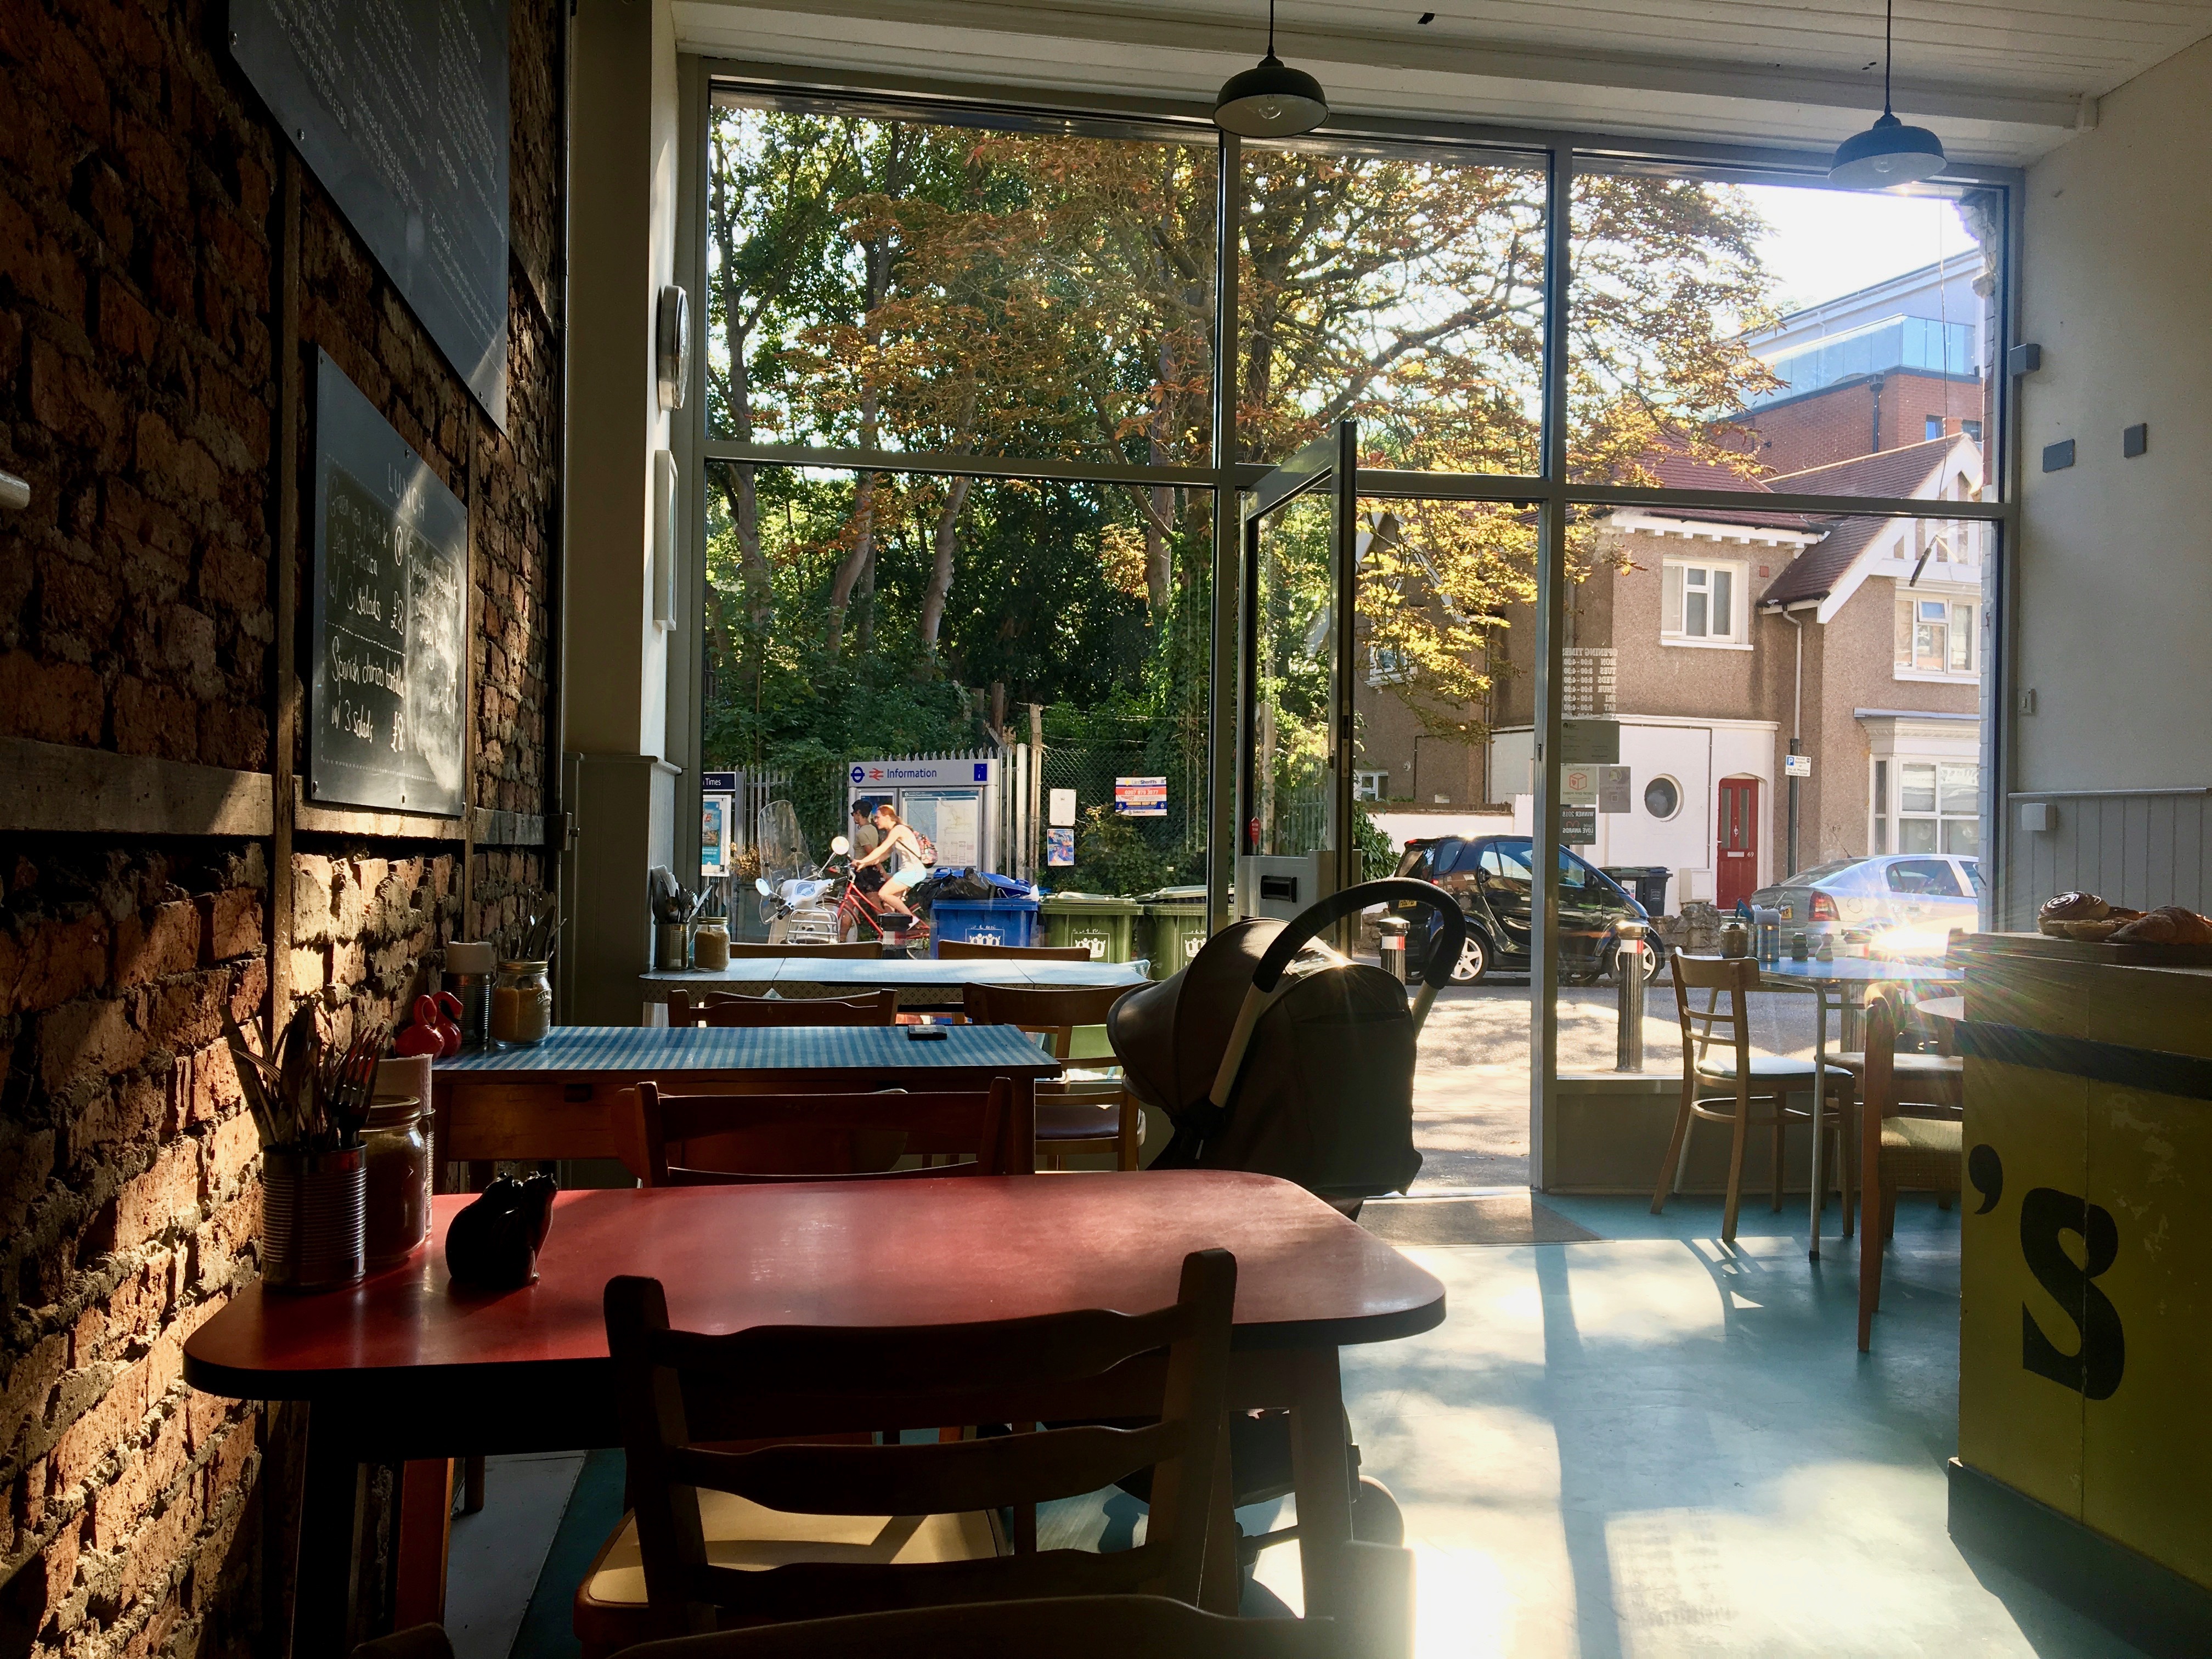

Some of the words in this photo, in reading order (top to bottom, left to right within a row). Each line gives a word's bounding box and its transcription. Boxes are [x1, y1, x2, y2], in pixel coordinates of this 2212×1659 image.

[387, 462, 426, 522] LUNCH
[346, 575, 354, 611] 3
[390, 590, 404, 635] £8
[345, 699, 351, 731] 3
[391, 710, 404, 753] £8
[887, 768, 937, 778] Information
[1788, 757, 1793, 765] P
[705, 777, 721, 786] Times
